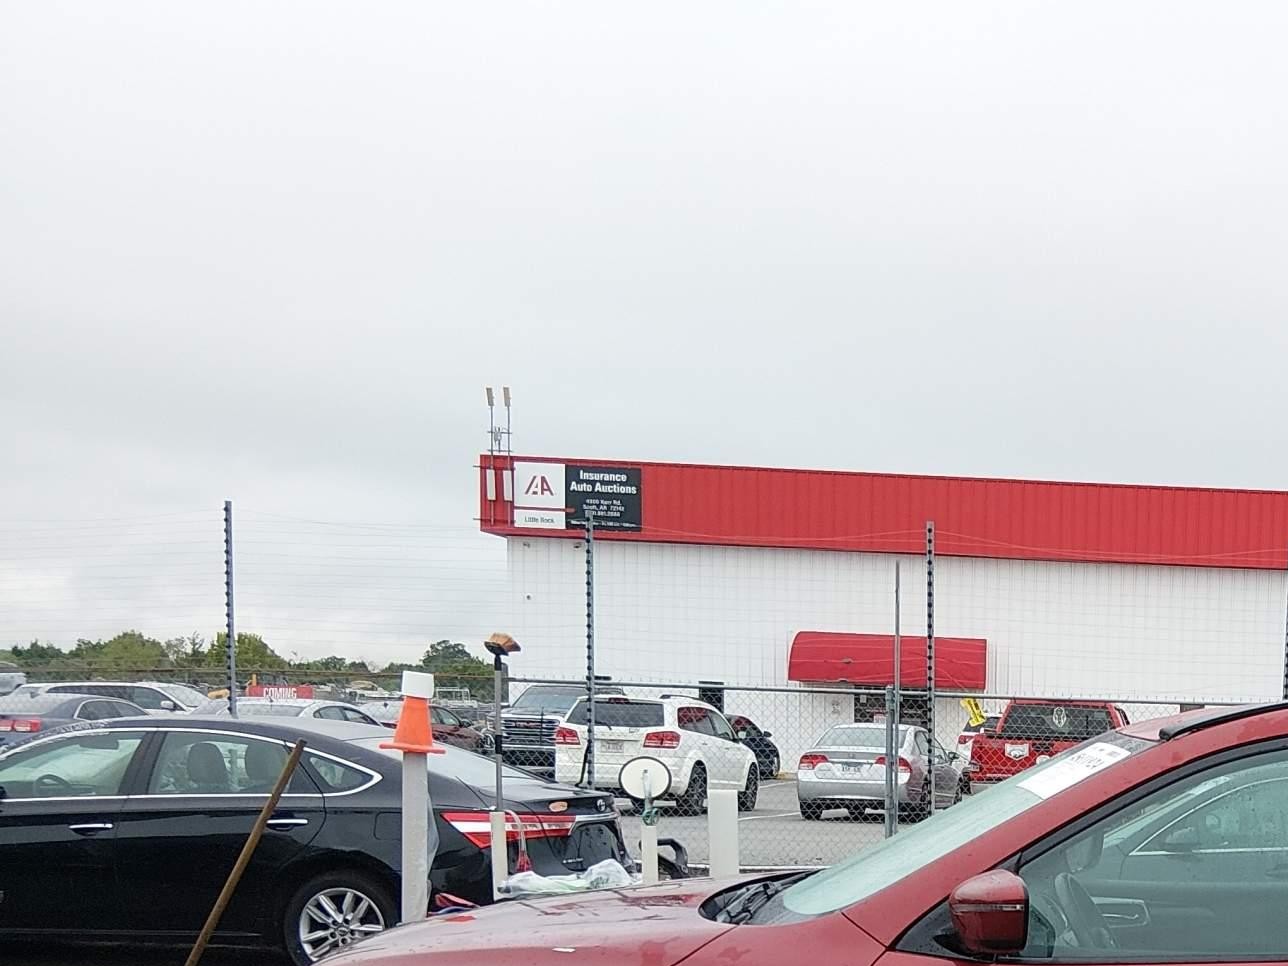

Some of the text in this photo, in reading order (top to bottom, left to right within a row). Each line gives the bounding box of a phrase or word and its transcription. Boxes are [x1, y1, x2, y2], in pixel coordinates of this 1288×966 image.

[579, 469, 628, 482] Insurance
[570, 481, 637, 495] Auto Auctions
[524, 515, 539, 524] Little
[263, 687, 297, 699] COMING
